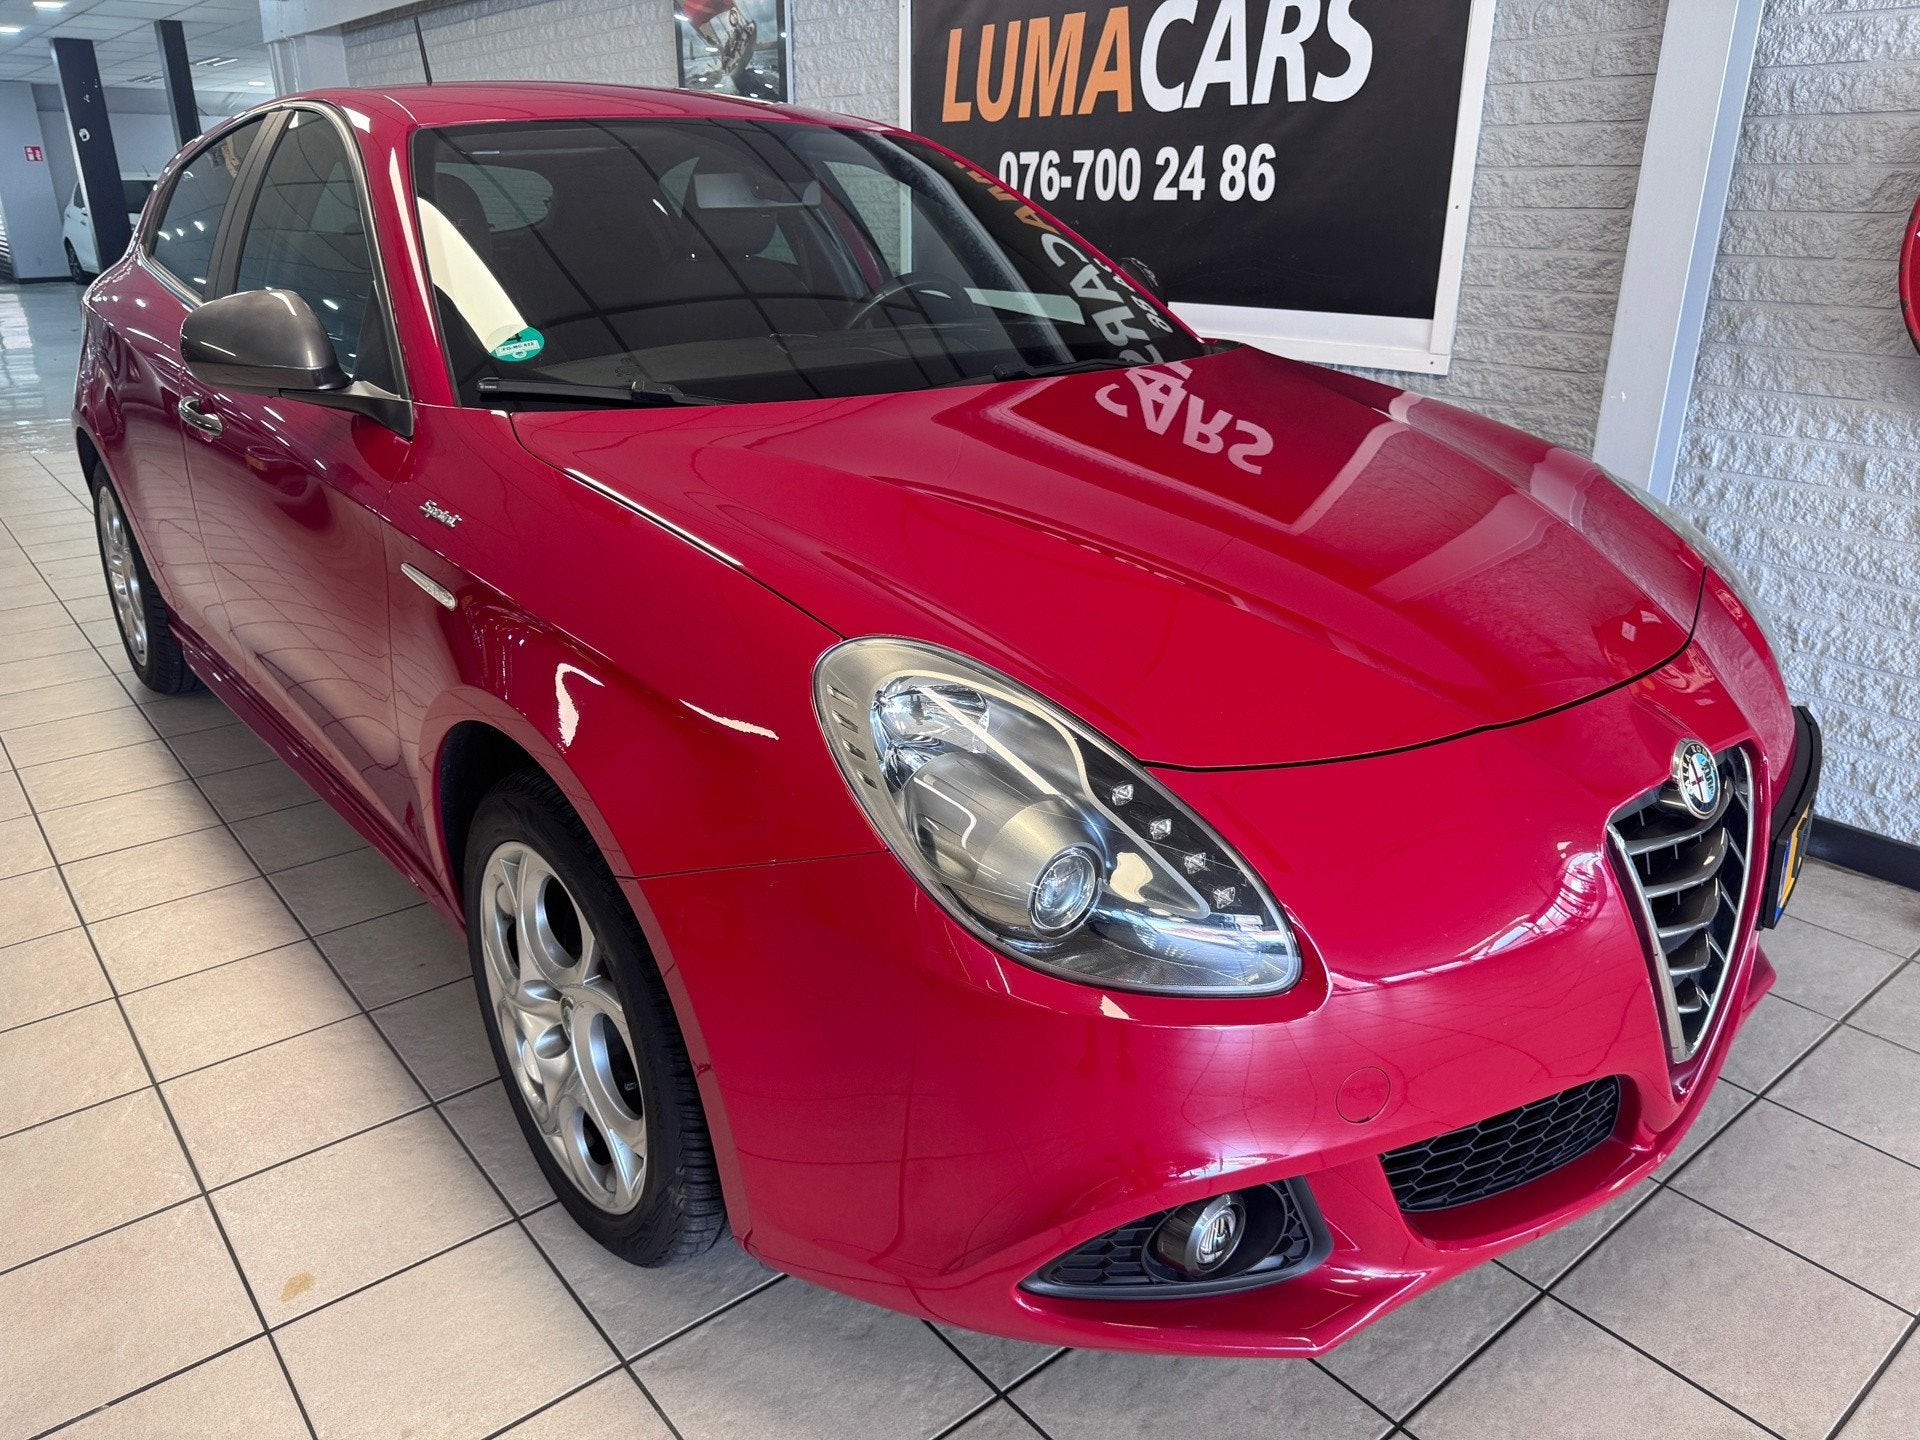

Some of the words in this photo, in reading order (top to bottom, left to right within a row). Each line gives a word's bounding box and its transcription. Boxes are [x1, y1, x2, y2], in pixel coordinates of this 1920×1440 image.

[942, 0, 1373, 123] LUMACARS
[999, 148, 1141, 201] 076-700
[1153, 145, 1206, 201] 24
[1219, 143, 1276, 201] 86
